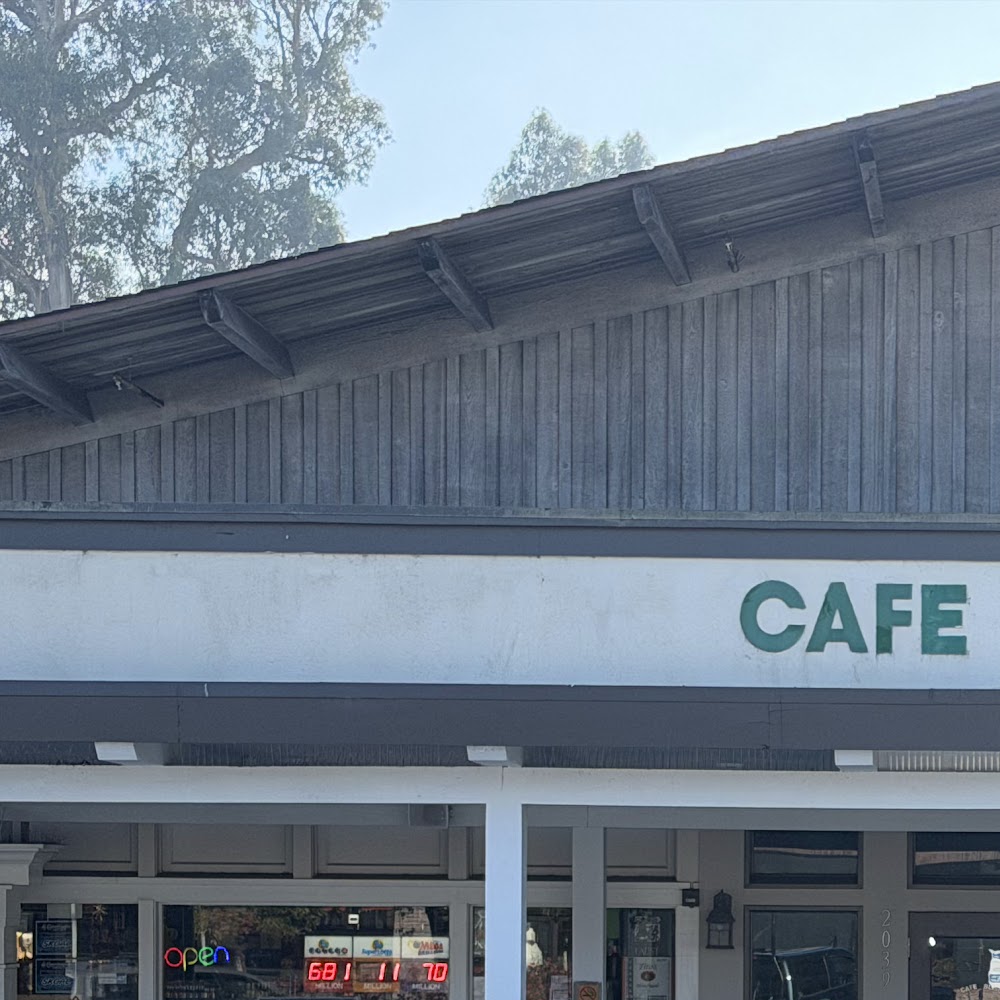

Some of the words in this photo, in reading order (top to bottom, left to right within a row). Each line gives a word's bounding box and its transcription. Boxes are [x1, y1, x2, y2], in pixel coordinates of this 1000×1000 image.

[739, 580, 968, 653] CAFE
[164, 946, 230, 972] open
[881, 909, 892, 988] 2039
[308, 962, 352, 981] 681
[423, 962, 448, 982] 70
[412, 982, 441, 990] MILLION
